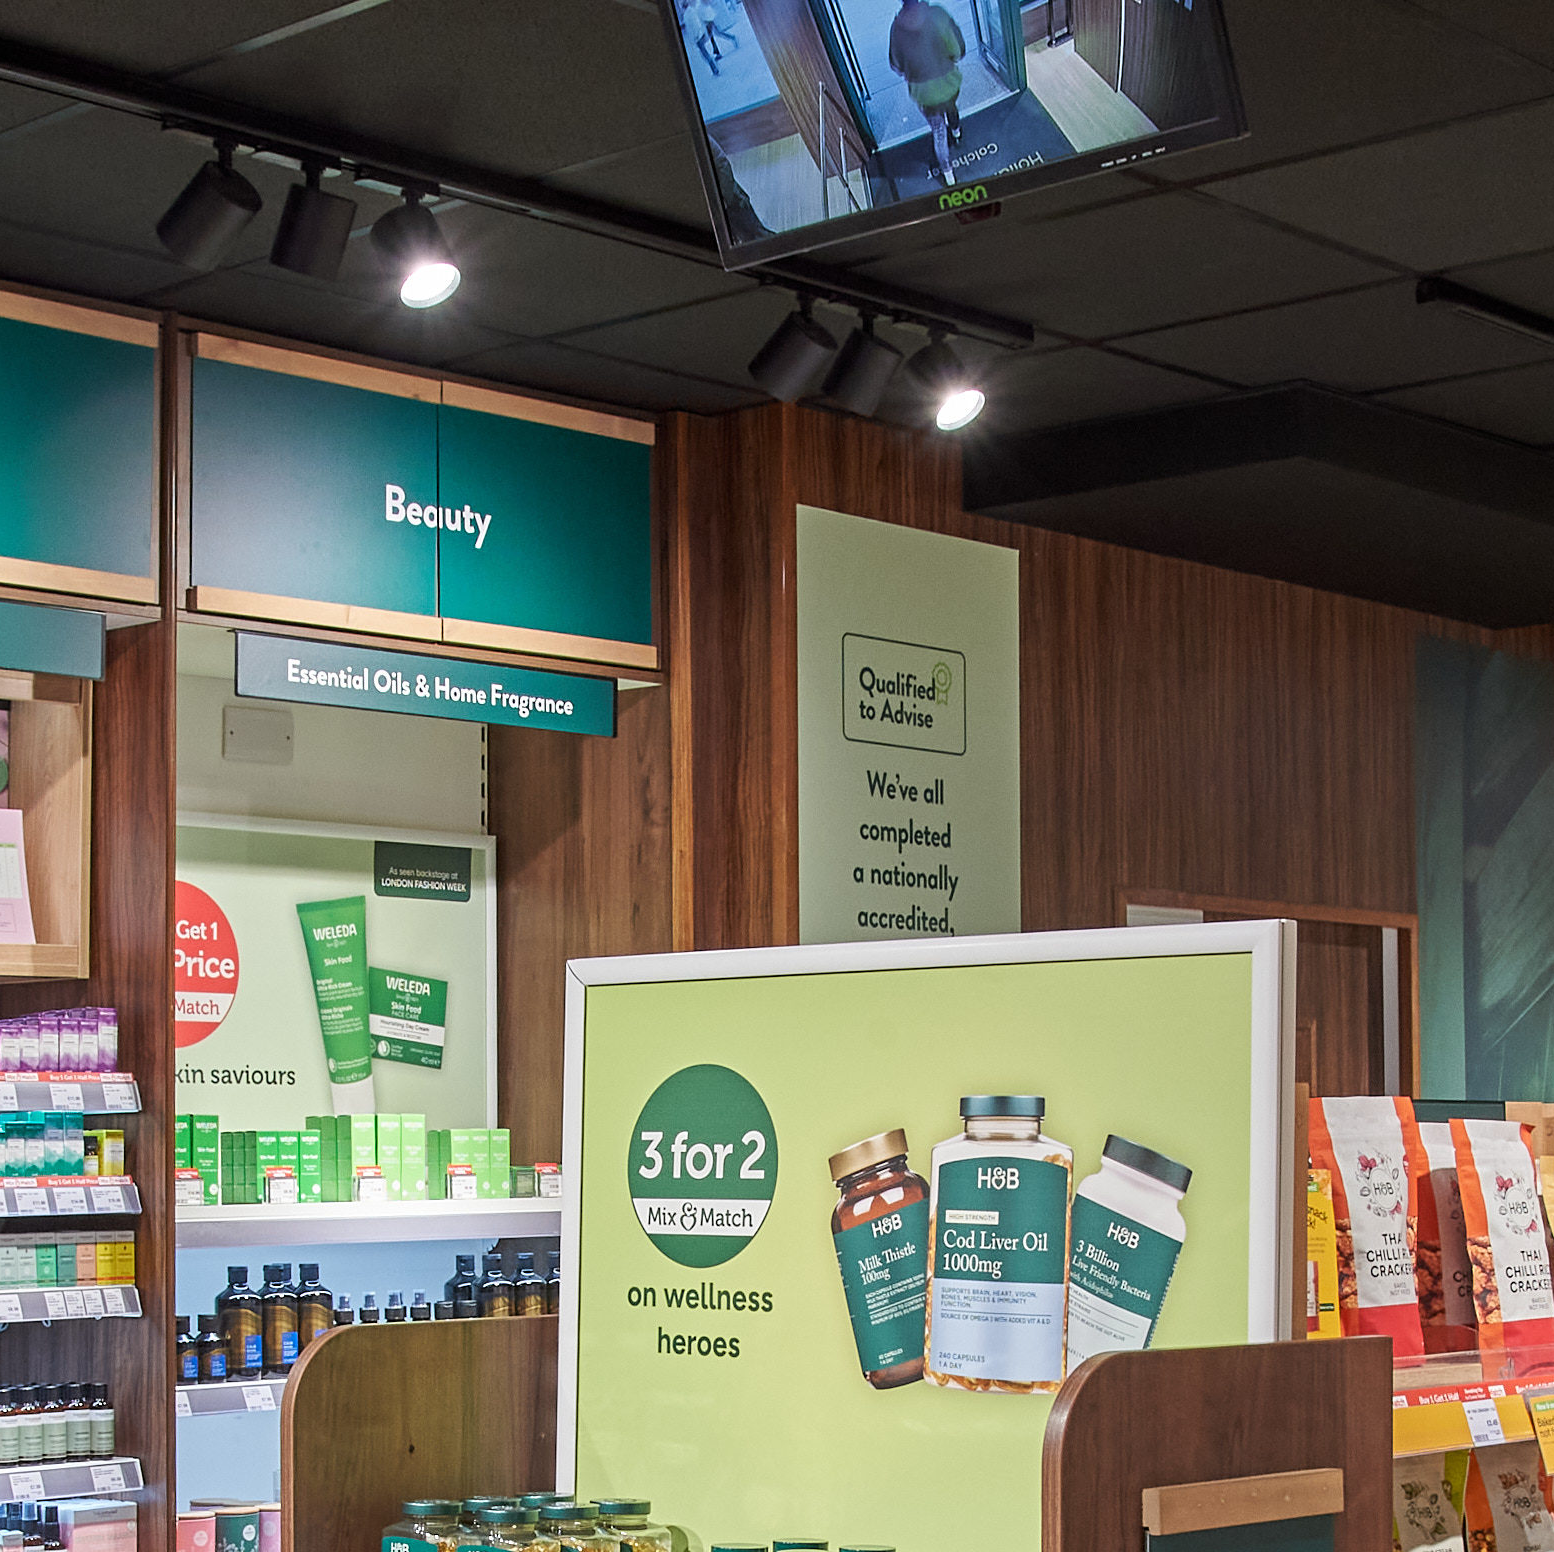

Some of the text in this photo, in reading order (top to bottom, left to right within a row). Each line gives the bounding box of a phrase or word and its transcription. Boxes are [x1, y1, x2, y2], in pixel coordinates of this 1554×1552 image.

[938, 183, 988, 210] neon
[385, 484, 492, 549] Beauty
[287, 659, 574, 718] Essential Oils & Home Fragrance
[859, 667, 936, 701] Qualified
[859, 699, 933, 728] to Advise
[867, 770, 944, 805] We've all
[860, 818, 951, 853] completed
[381, 878, 466, 892] LONDON FASHION WEEK
[389, 867, 399, 876] As
[401, 869, 415, 877] seen
[416, 869, 448, 881] backstage
[853, 861, 958, 901] a nationally
[176, 920, 218, 940] Get 1
[313, 923, 357, 941] WELEDA
[857, 905, 954, 937] accredited,
[175, 949, 235, 978] Price
[386, 976, 431, 997] WELEDA
[176, 999, 220, 1015] Match
[391, 1001, 421, 1014] Skin Food
[176, 1065, 295, 1085] kin saviours
[639, 1130, 766, 1180] 3 for 2
[977, 1168, 1020, 1190] H&B
[647, 1202, 754, 1230] Mix & Match
[872, 1213, 903, 1238] H&B
[943, 1229, 1048, 1252] Cod Liver Oil
[858, 1242, 916, 1274] Milk Thistle
[943, 1253, 1002, 1278] 1000mg
[1076, 1239, 1120, 1272] 3 Billion
[1520, 1250, 1542, 1262] THAI
[861, 1267, 890, 1286] 100mg
[1506, 1264, 1536, 1279] CHILLI
[627, 1283, 773, 1313] on wellness
[657, 1326, 740, 1358] heroes
